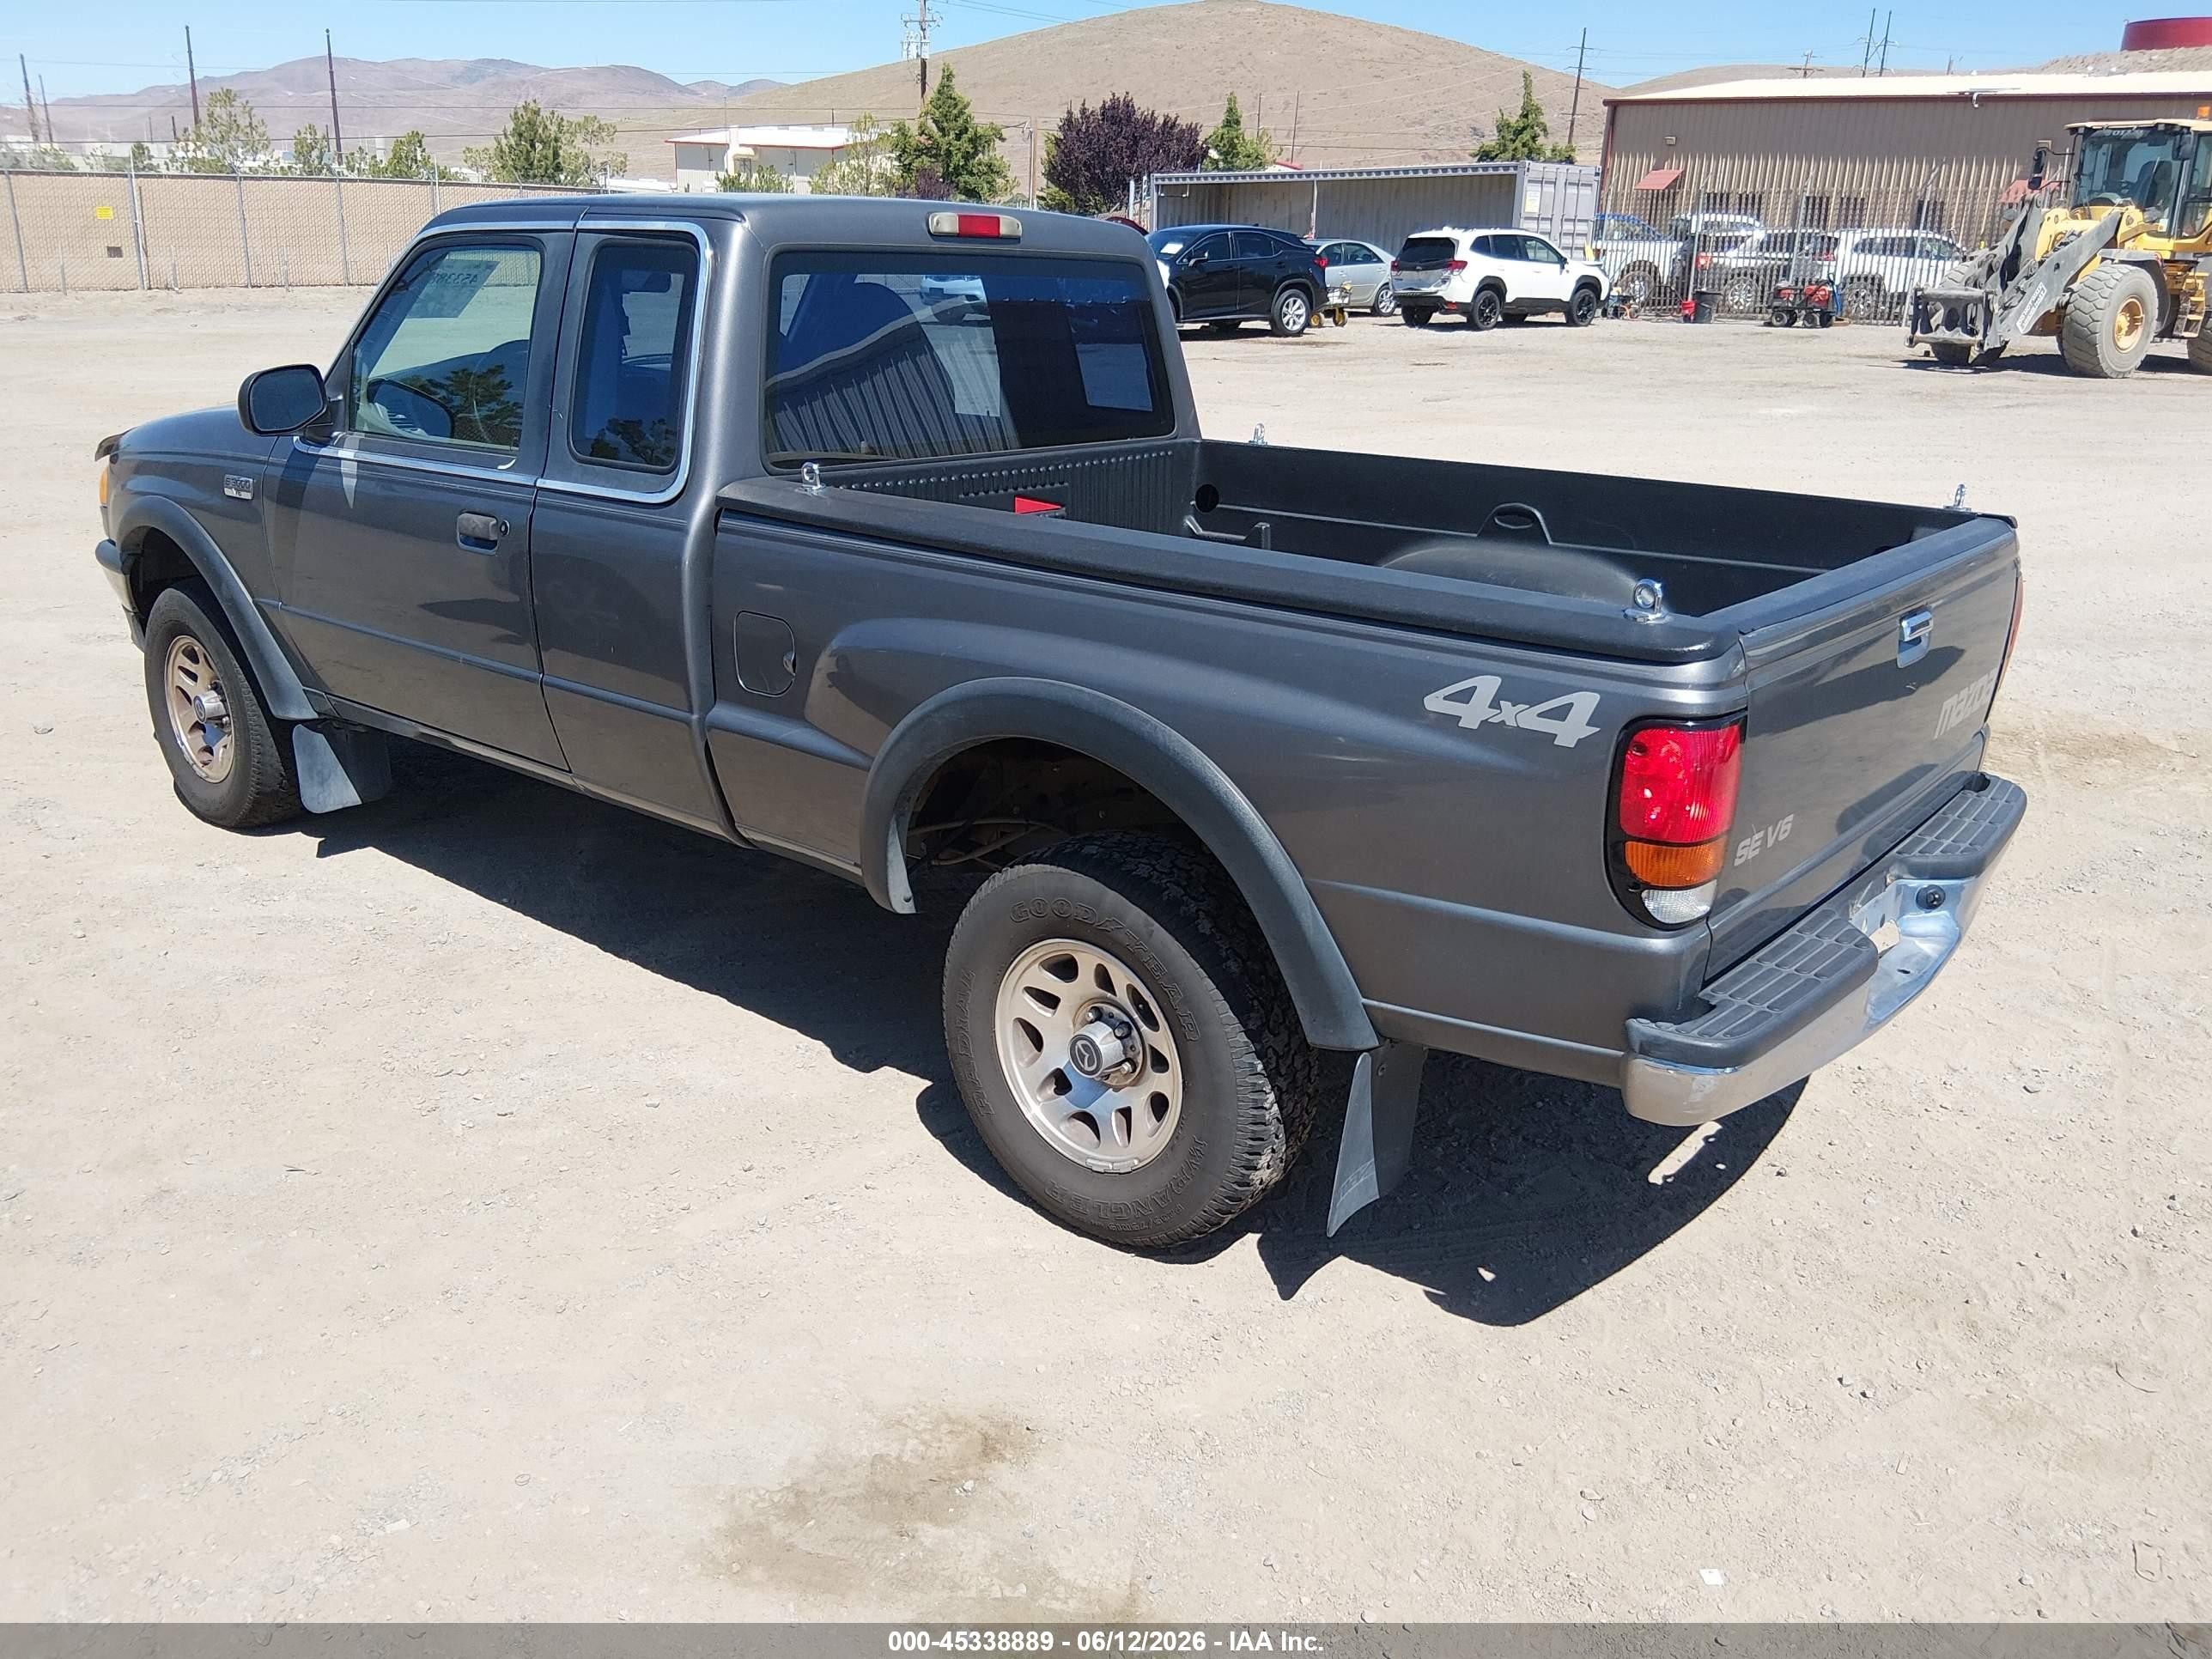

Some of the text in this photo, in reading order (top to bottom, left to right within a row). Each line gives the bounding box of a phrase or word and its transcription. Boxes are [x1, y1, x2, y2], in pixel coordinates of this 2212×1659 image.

[1423, 675, 1601, 748] 4x4
[1734, 813, 1794, 866] SE V6
[1010, 897, 1200, 1042] GOODYEAR
[1043, 1134, 1208, 1222] WRANGLER
